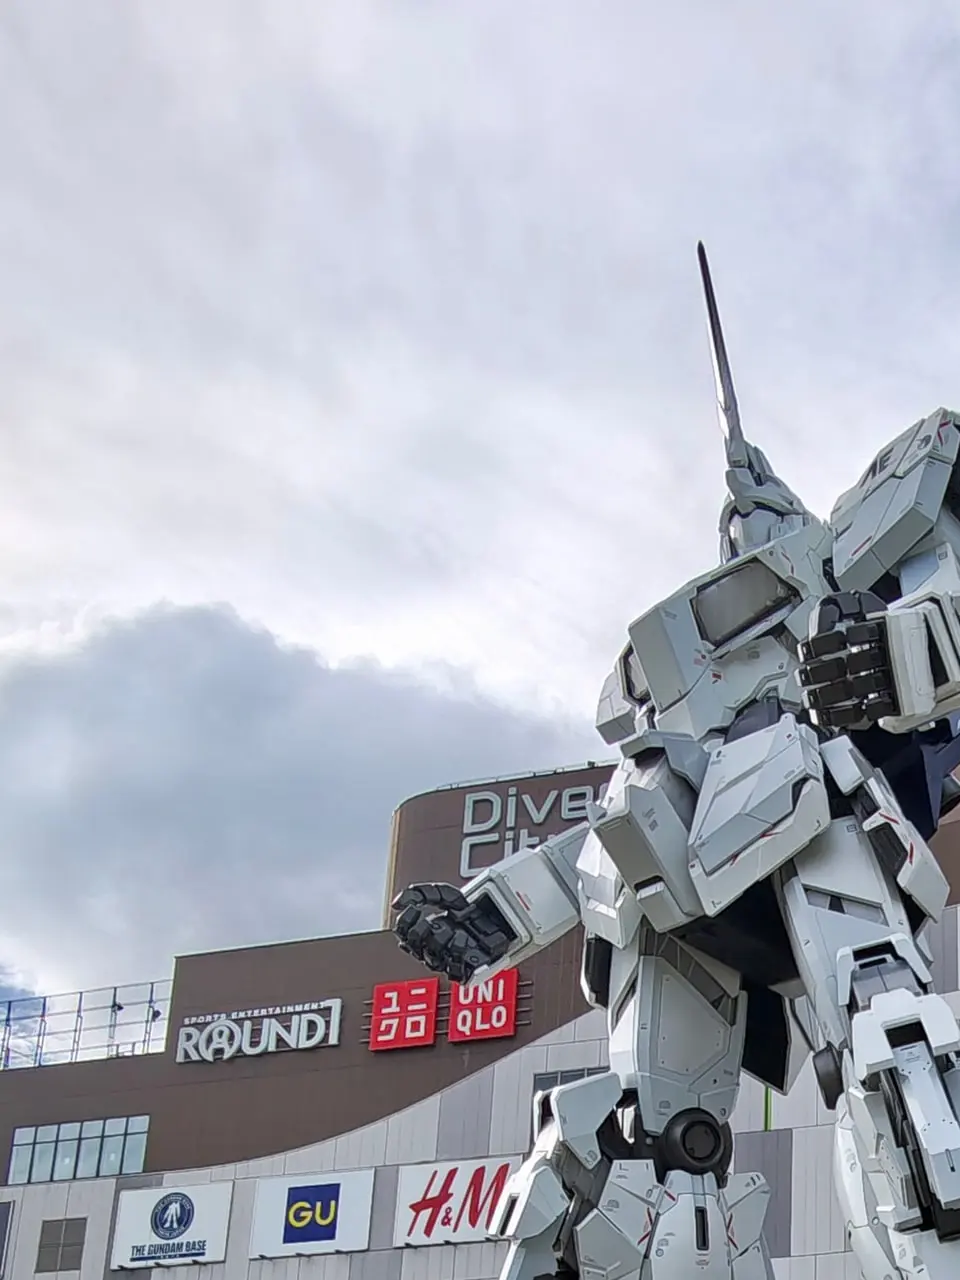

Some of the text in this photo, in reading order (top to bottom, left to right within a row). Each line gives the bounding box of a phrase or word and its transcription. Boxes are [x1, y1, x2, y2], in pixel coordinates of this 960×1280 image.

[460, 828, 558, 878] Cit
[458, 979, 505, 1005] UNI
[184, 1001, 326, 1025] SPORTS ENTERTAINMENT
[457, 1005, 507, 1036] QLO
[175, 998, 342, 1063] ROUND1
[288, 1200, 336, 1228] GU
[407, 1163, 510, 1238] H&M
[131, 1240, 207, 1257] THE GUNDAM BASE
